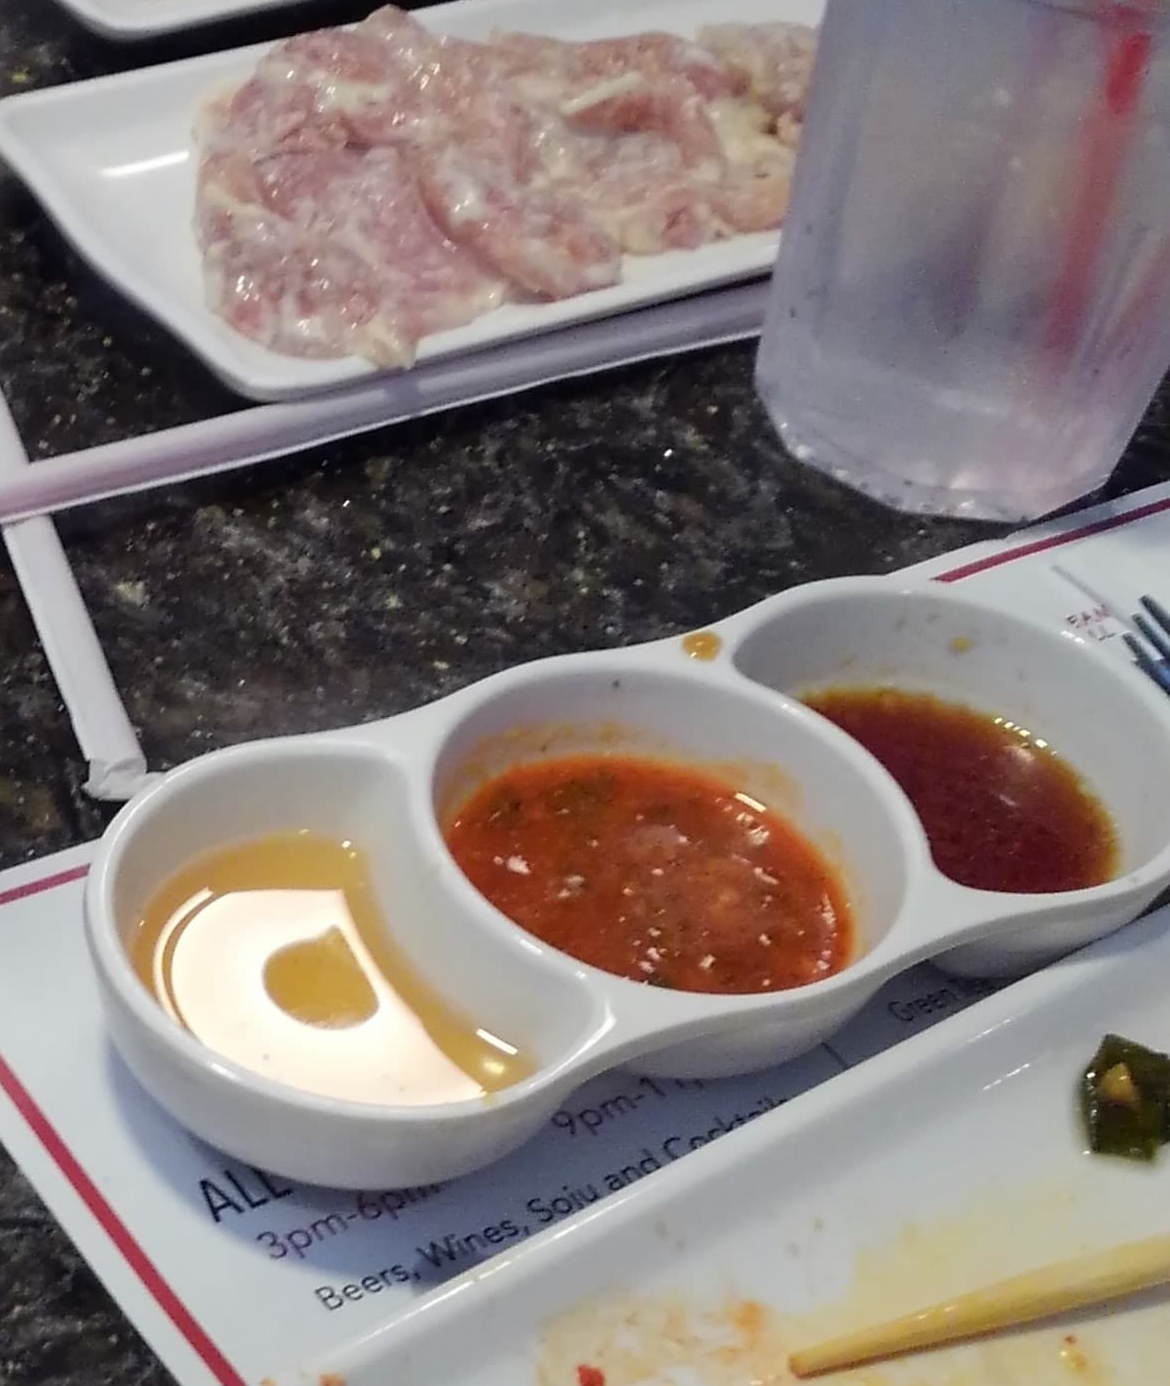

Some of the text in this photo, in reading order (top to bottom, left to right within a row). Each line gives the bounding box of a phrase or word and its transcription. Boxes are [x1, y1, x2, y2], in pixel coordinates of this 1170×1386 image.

[314, 1260, 423, 1312] Beers,
[415, 1215, 532, 1270] Wines,
[603, 1147, 663, 1193] and
